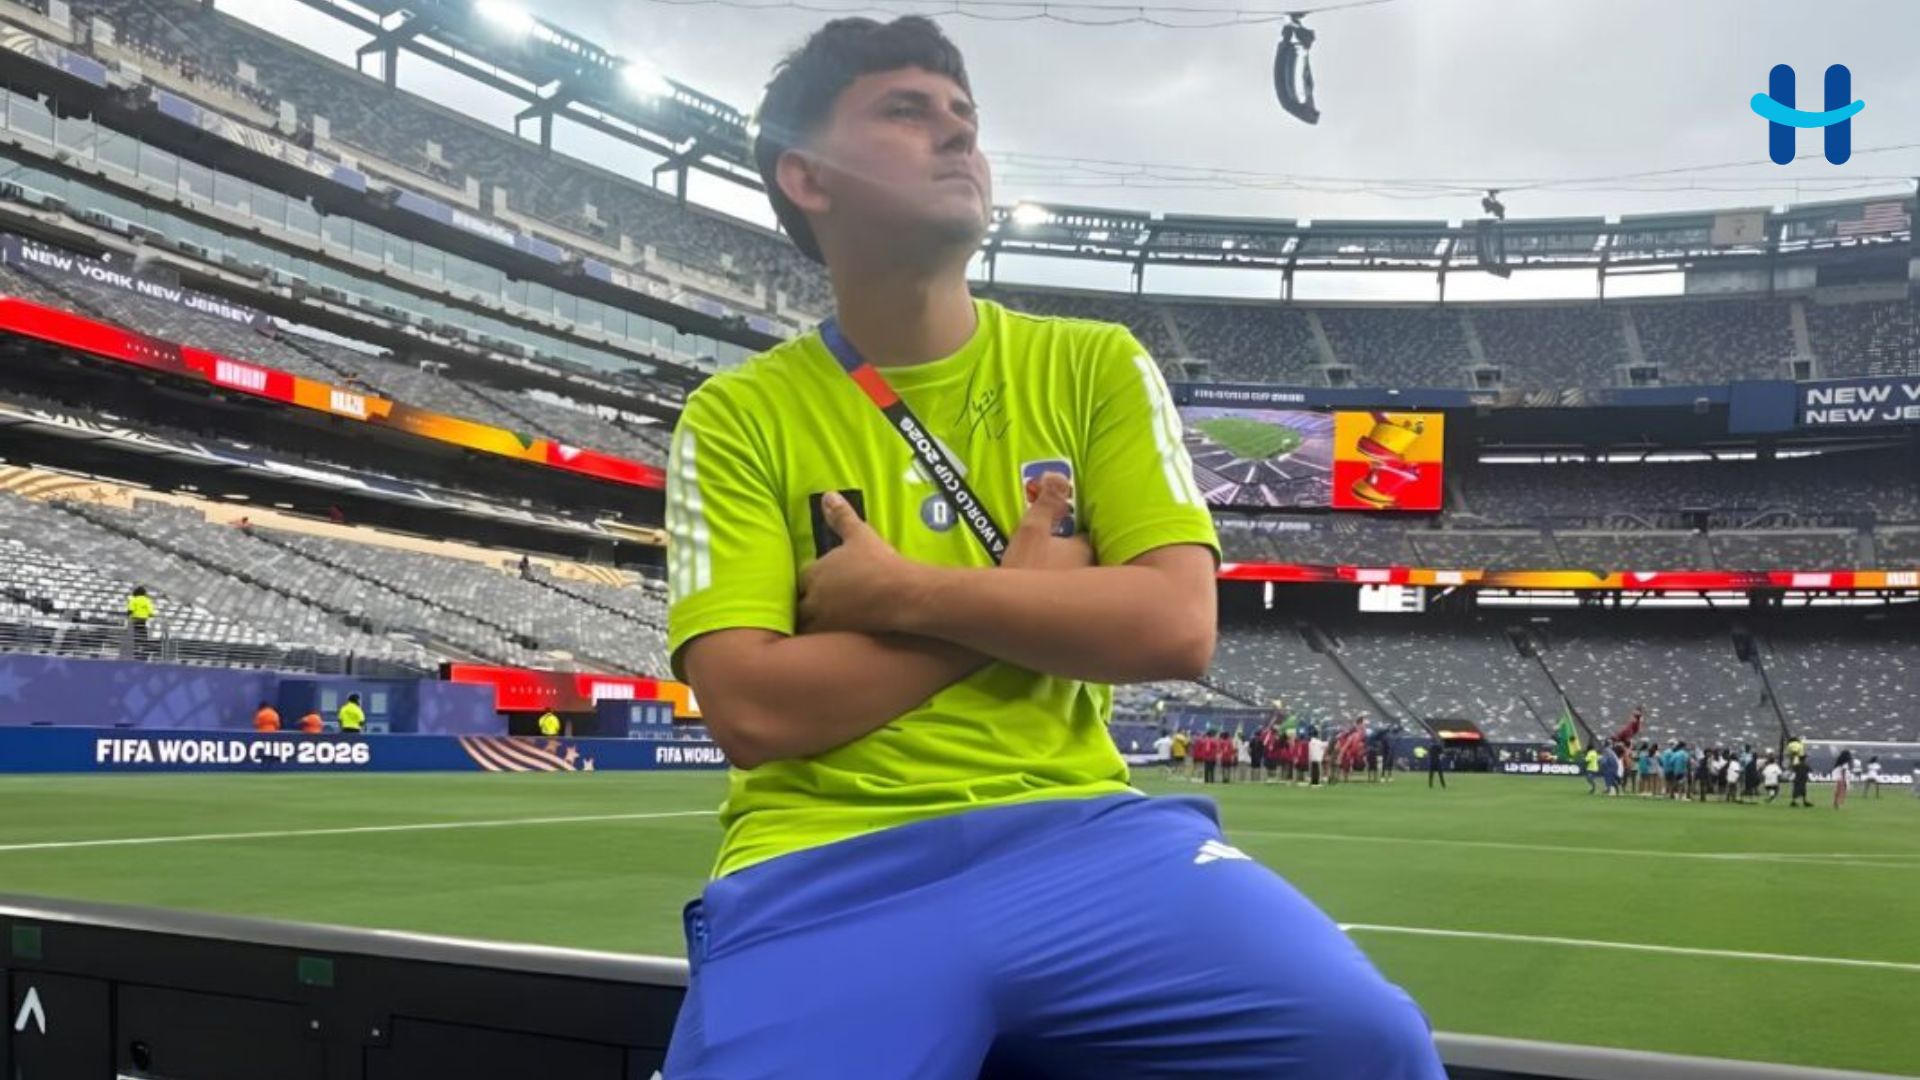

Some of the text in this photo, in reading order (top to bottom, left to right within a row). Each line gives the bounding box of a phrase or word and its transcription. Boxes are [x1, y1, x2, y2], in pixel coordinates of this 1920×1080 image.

[22, 246, 255, 325] NEW YORK NEW JERSEY
[1807, 385, 1892, 405] NEW
[1806, 408, 1875, 424] NEW
[934, 464, 959, 491] CUP
[956, 491, 996, 543] WORLD
[97, 739, 153, 763] FIFA
[158, 740, 247, 763] WORLD
[297, 743, 370, 763] 2026
[656, 747, 725, 763] FIFA WORLD
